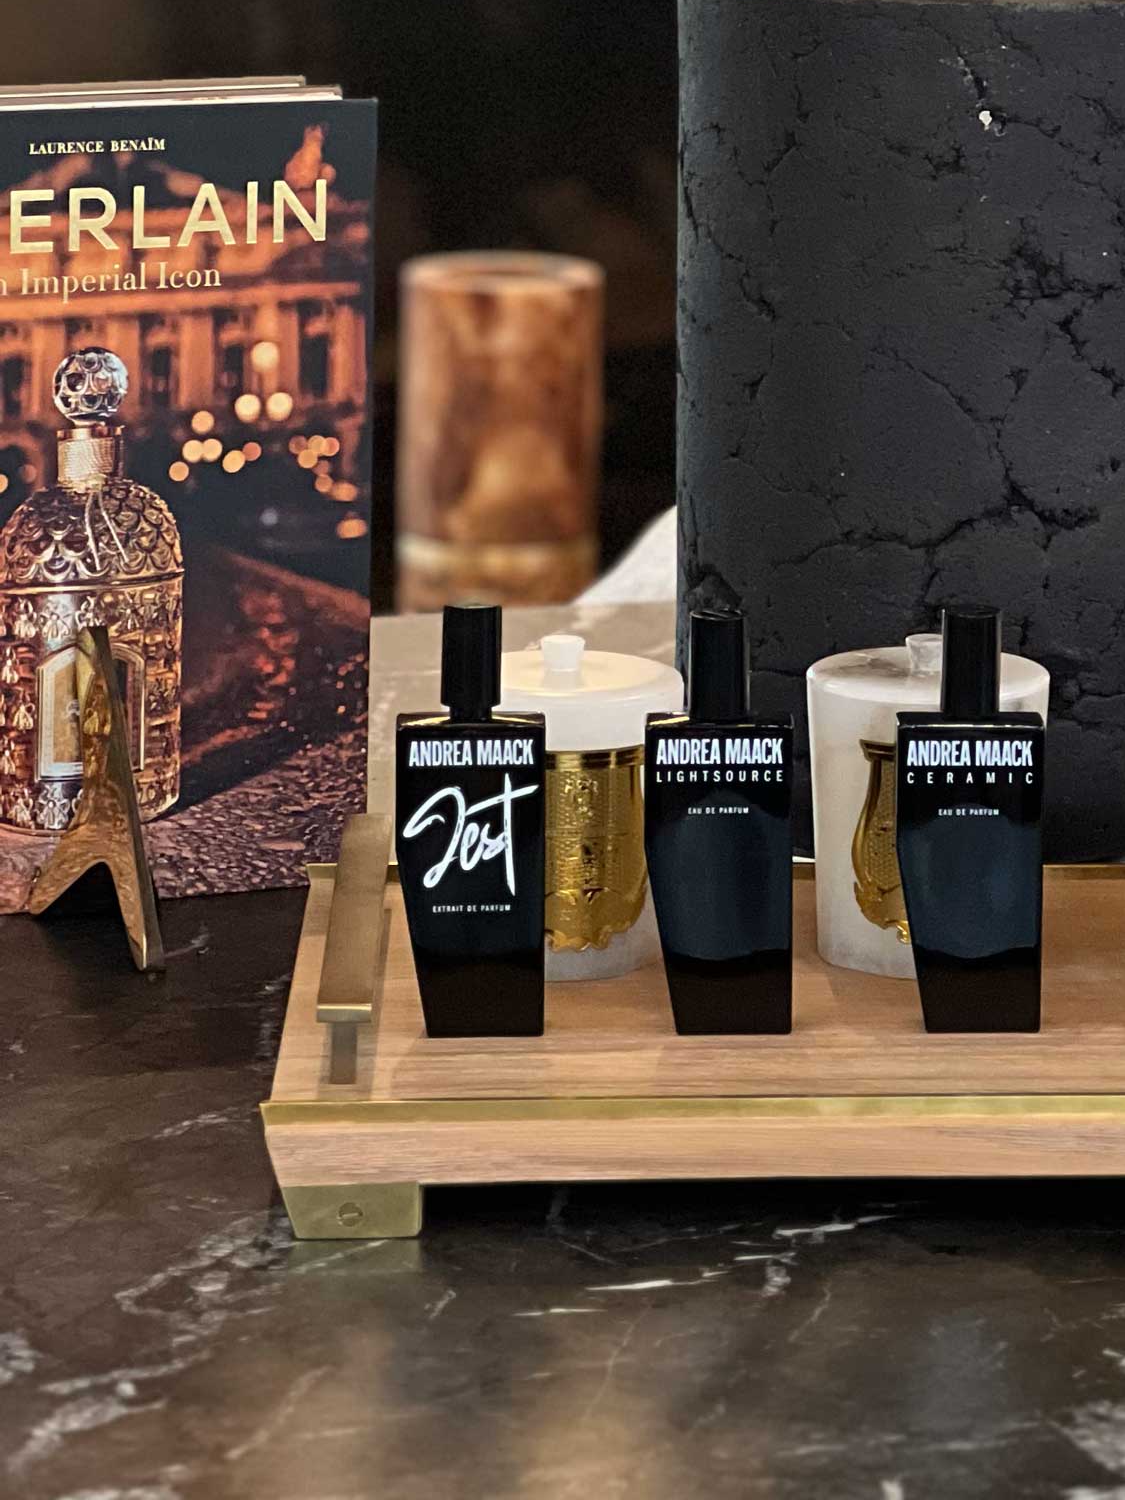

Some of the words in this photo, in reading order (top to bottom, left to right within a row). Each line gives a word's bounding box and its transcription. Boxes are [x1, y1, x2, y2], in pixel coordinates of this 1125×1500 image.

[29, 140, 105, 155] LAURENCE
[110, 137, 166, 152] BENAÏM
[10, 179, 327, 254] ERLAIN
[20, 262, 147, 304] Imperial
[156, 262, 221, 288] Icon
[409, 740, 472, 766] ANDREA
[477, 739, 533, 765] MAACK
[656, 739, 720, 764] ANDREA
[725, 738, 783, 764] MAACK
[907, 741, 971, 766] ANDREA
[976, 740, 1032, 766] MAACK
[656, 769, 783, 783] LIGHTSOURCE
[906, 771, 1033, 785] CERAMIC
[687, 807, 703, 815] EAU
[705, 806, 716, 815] DE
[718, 806, 749, 814] PARFUM
[938, 808, 953, 817] EAU
[955, 808, 966, 816] DE
[969, 808, 1000, 816] PARFUM
[432, 904, 464, 913] EXTRAIT
[466, 904, 477, 913] DE
[480, 904, 511, 912] PARFUM
